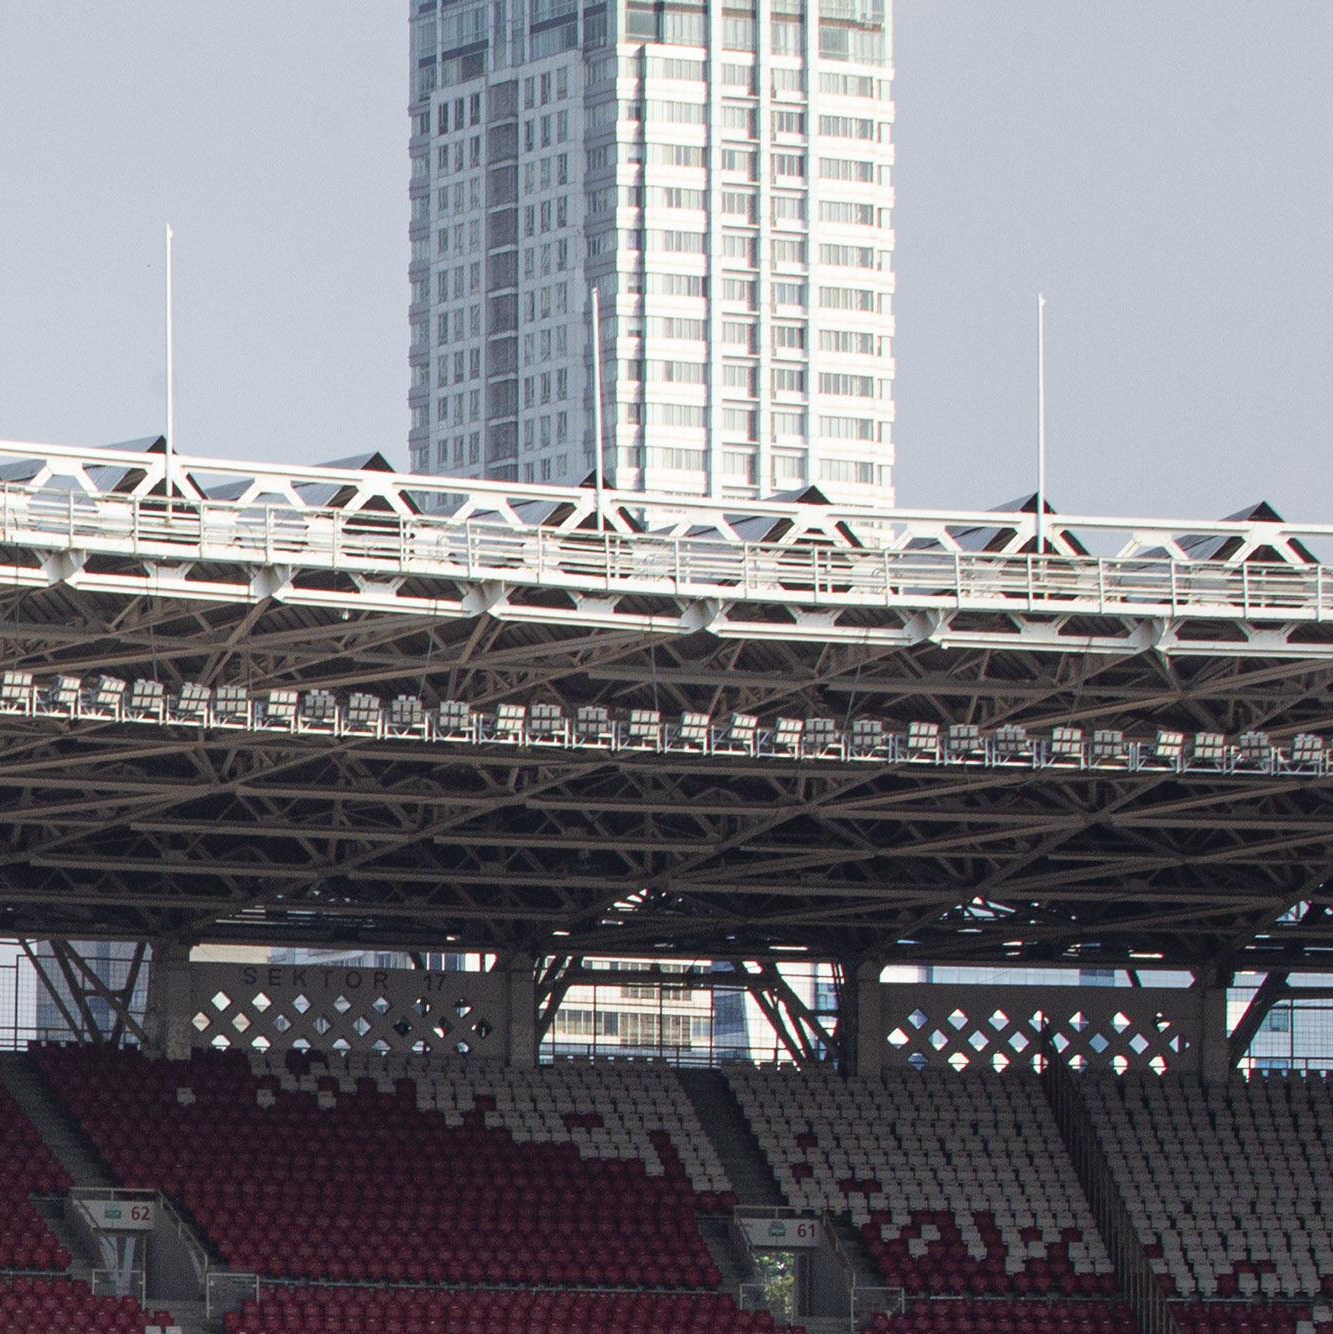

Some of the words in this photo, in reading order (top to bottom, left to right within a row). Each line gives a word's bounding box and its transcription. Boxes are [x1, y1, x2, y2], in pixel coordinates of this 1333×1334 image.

[243, 967, 388, 990] SEKTOR
[424, 973, 447, 991] 17
[131, 1206, 149, 1220] 62
[797, 1223, 815, 1238] 61
